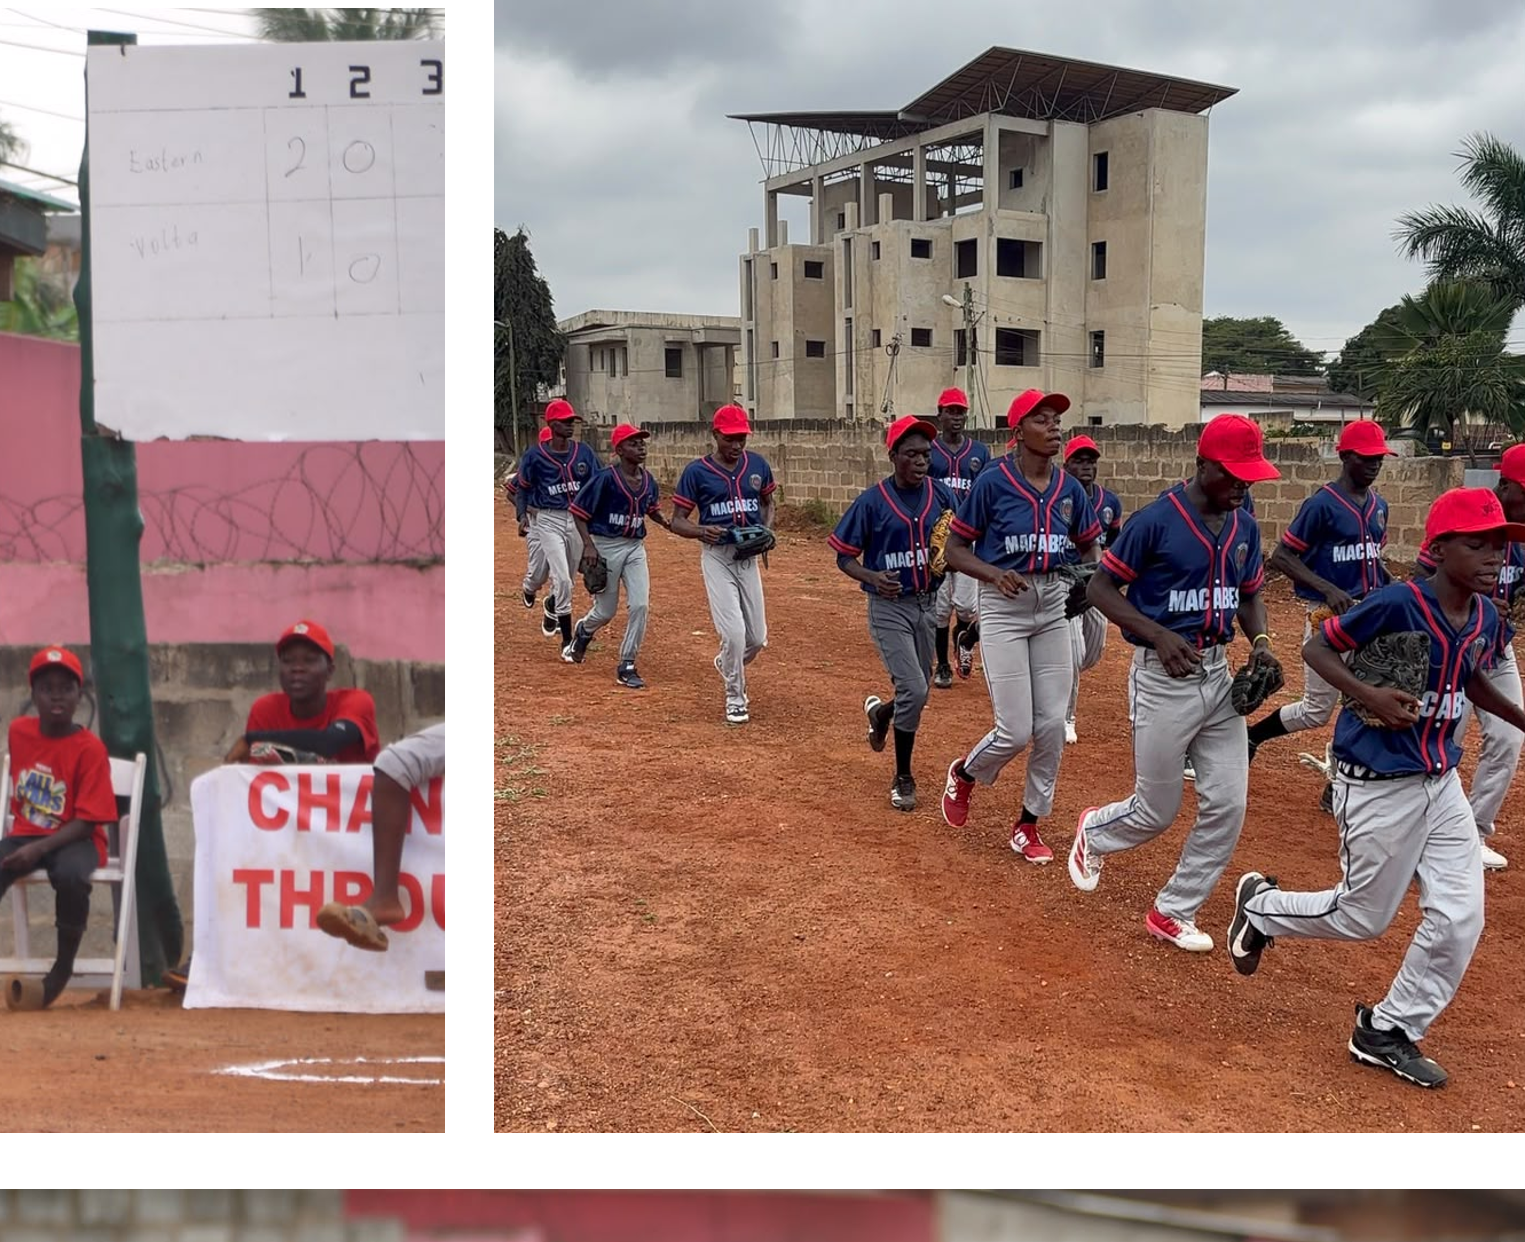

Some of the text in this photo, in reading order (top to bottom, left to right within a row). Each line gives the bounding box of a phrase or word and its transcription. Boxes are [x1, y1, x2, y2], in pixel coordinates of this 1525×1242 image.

[289, 59, 443, 98] 1 2 3
